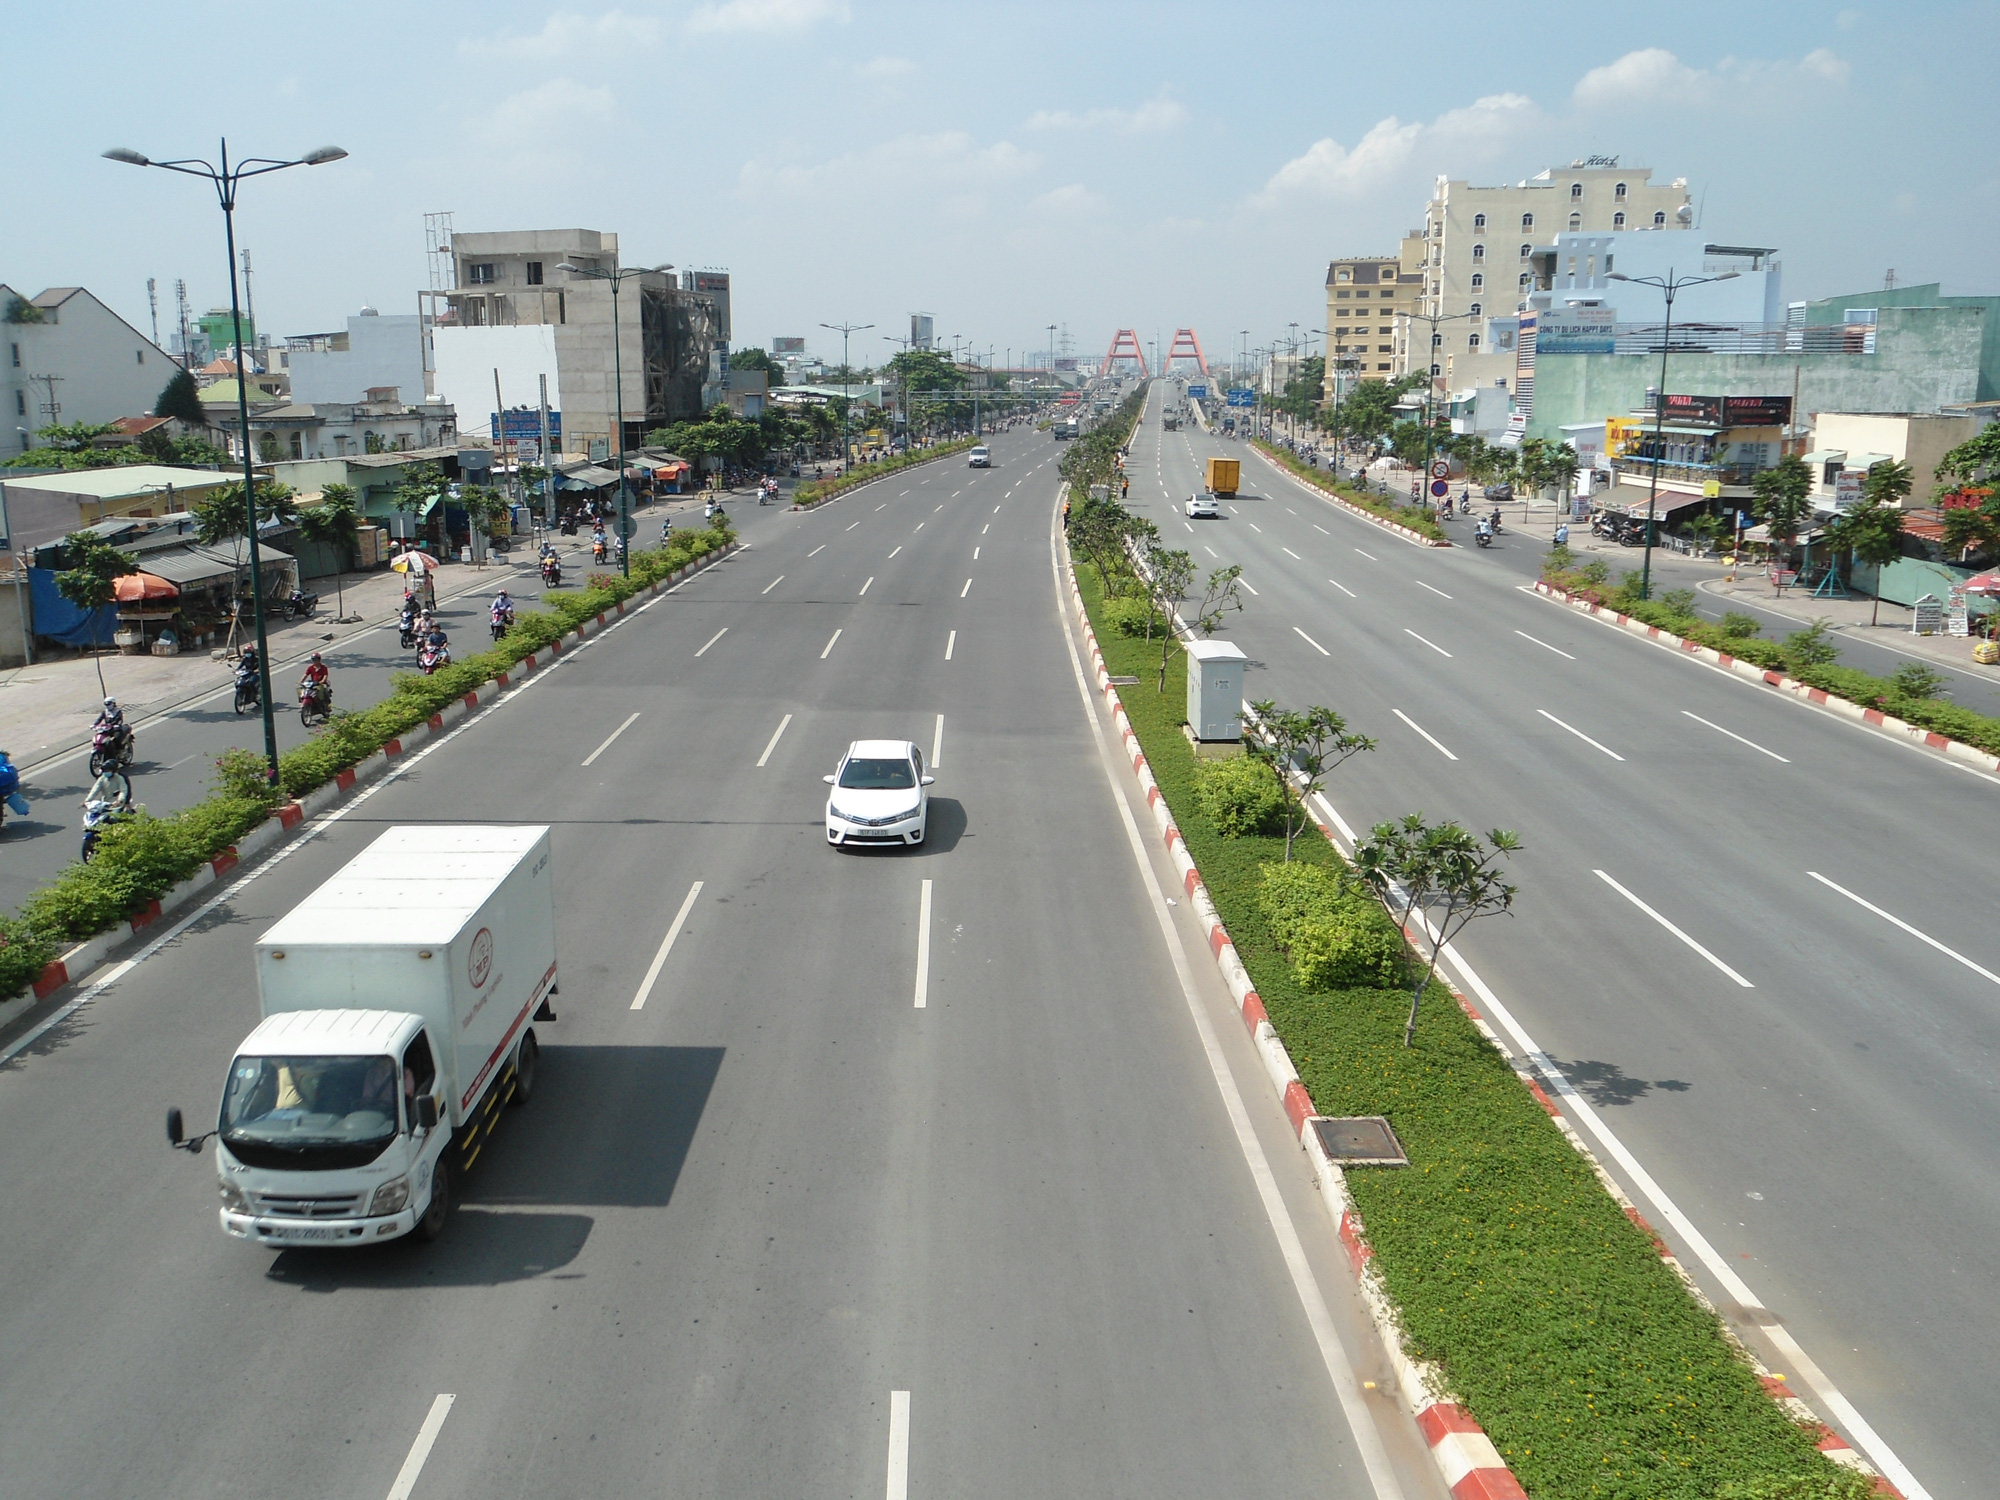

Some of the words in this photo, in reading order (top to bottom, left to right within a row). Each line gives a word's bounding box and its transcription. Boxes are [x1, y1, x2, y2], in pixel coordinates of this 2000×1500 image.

[1554, 325, 1561, 333] TY
[1582, 325, 1599, 333] HAPPY
[1600, 325, 1613, 333] DAYS
